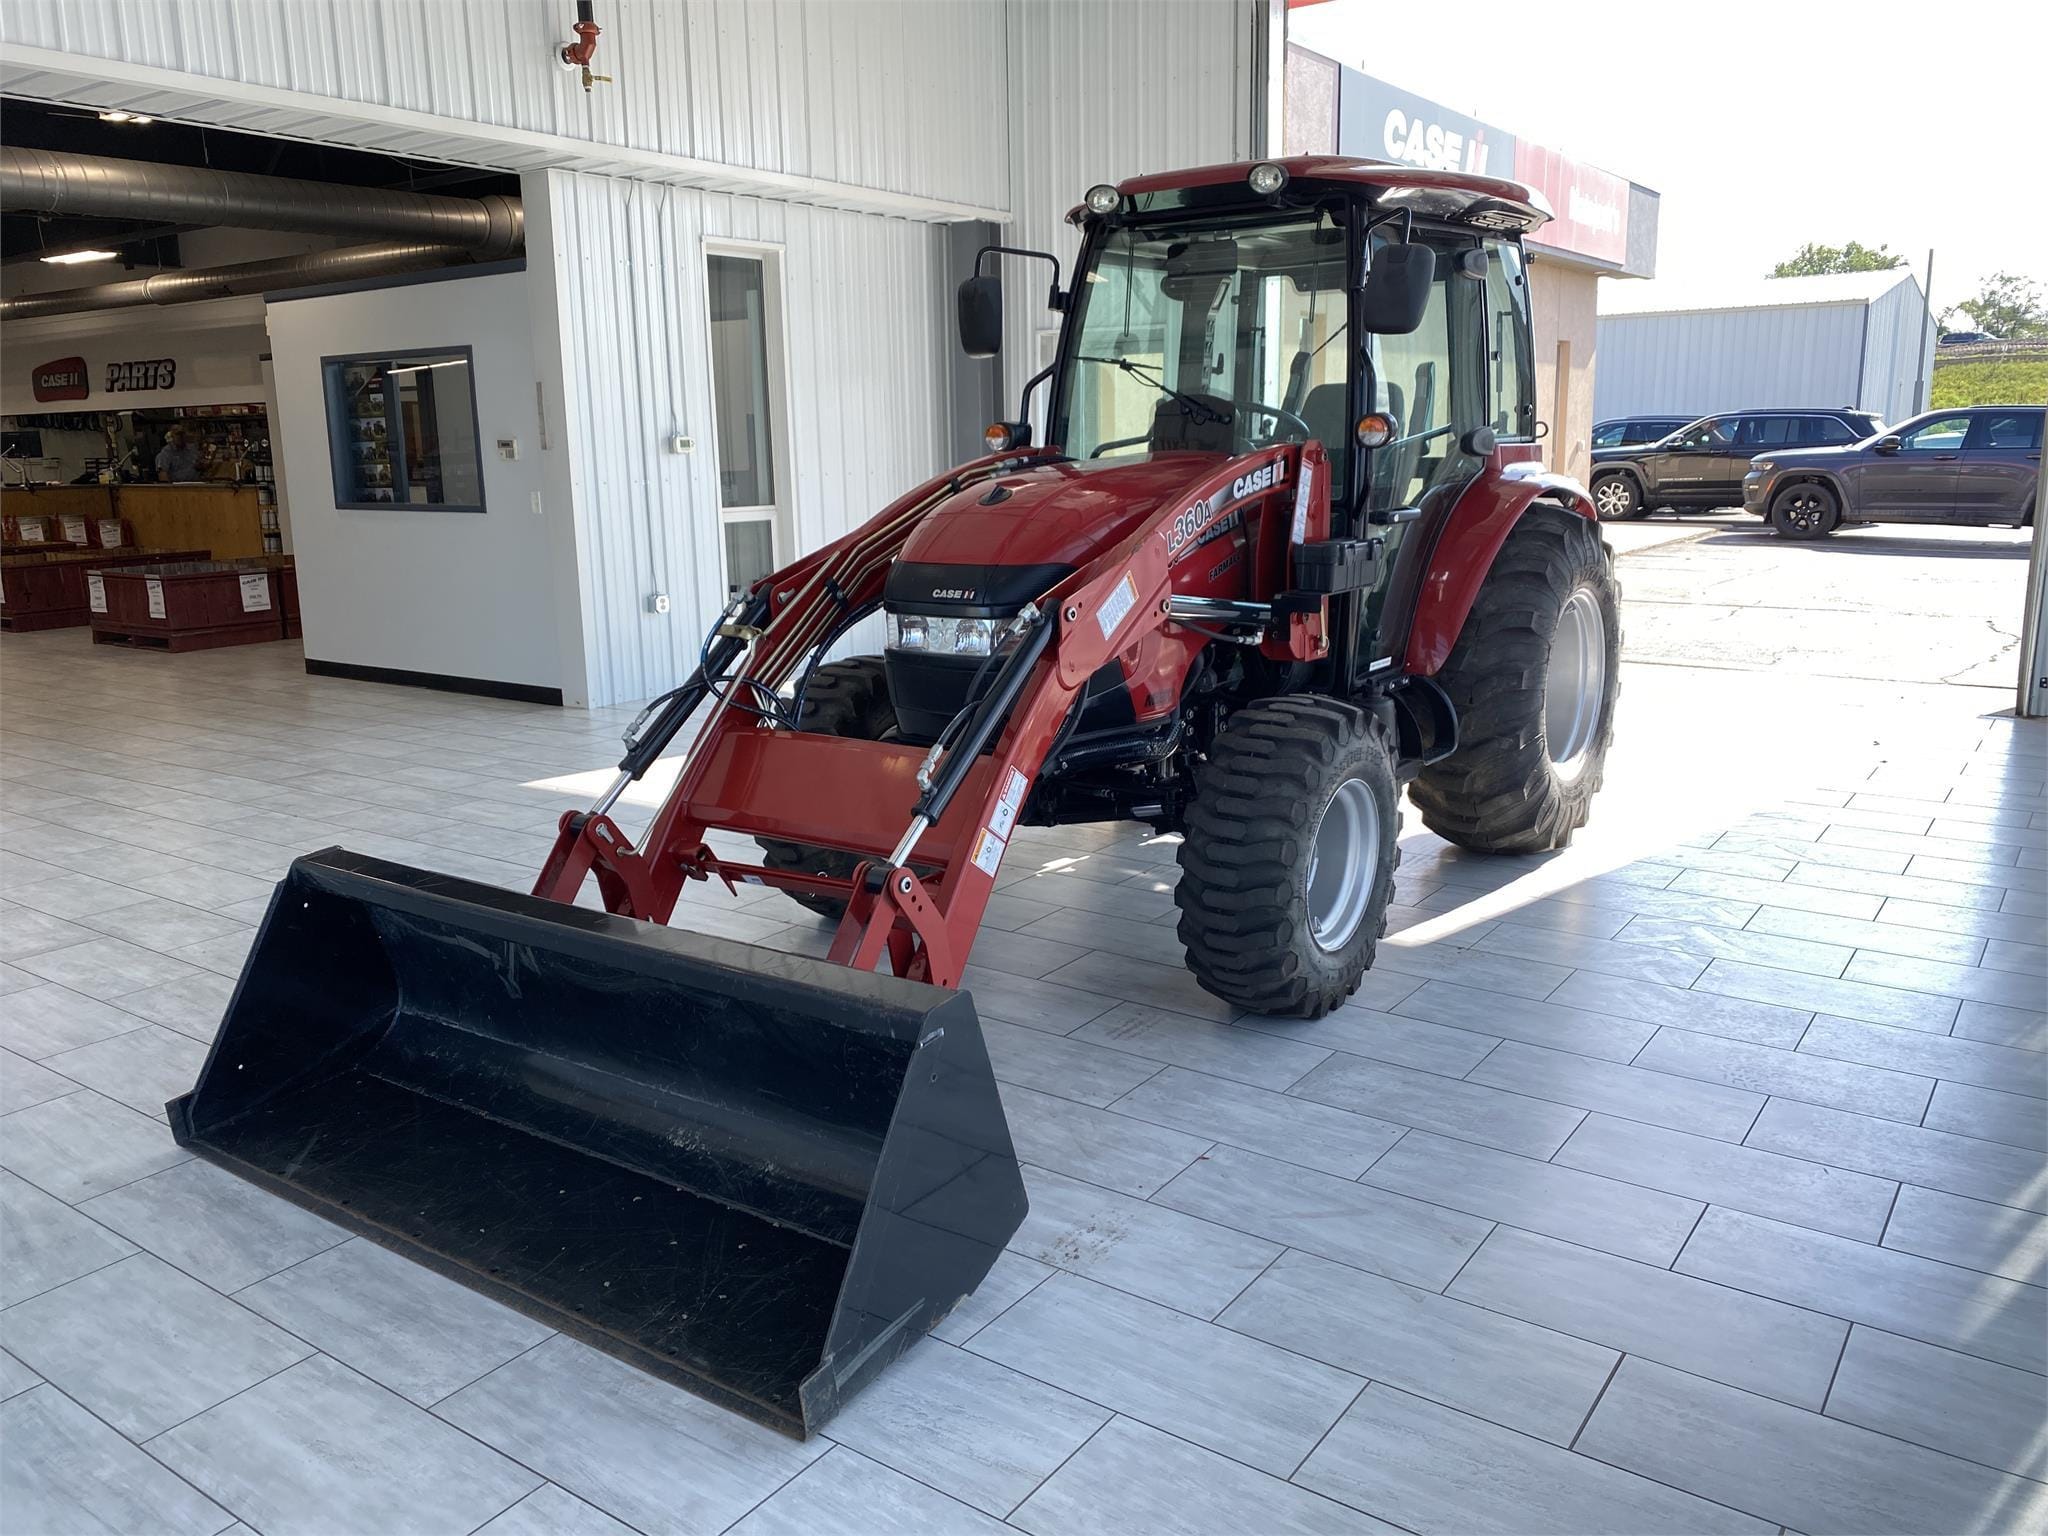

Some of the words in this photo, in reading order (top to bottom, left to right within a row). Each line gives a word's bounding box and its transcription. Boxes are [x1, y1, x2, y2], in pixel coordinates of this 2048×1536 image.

[1383, 108, 1463, 172] CASE
[41, 373, 68, 388] CASE
[105, 358, 176, 393] PARTS
[1233, 466, 1272, 499] CASE
[1167, 500, 1212, 555] L360A
[932, 588, 963, 599] CASE
